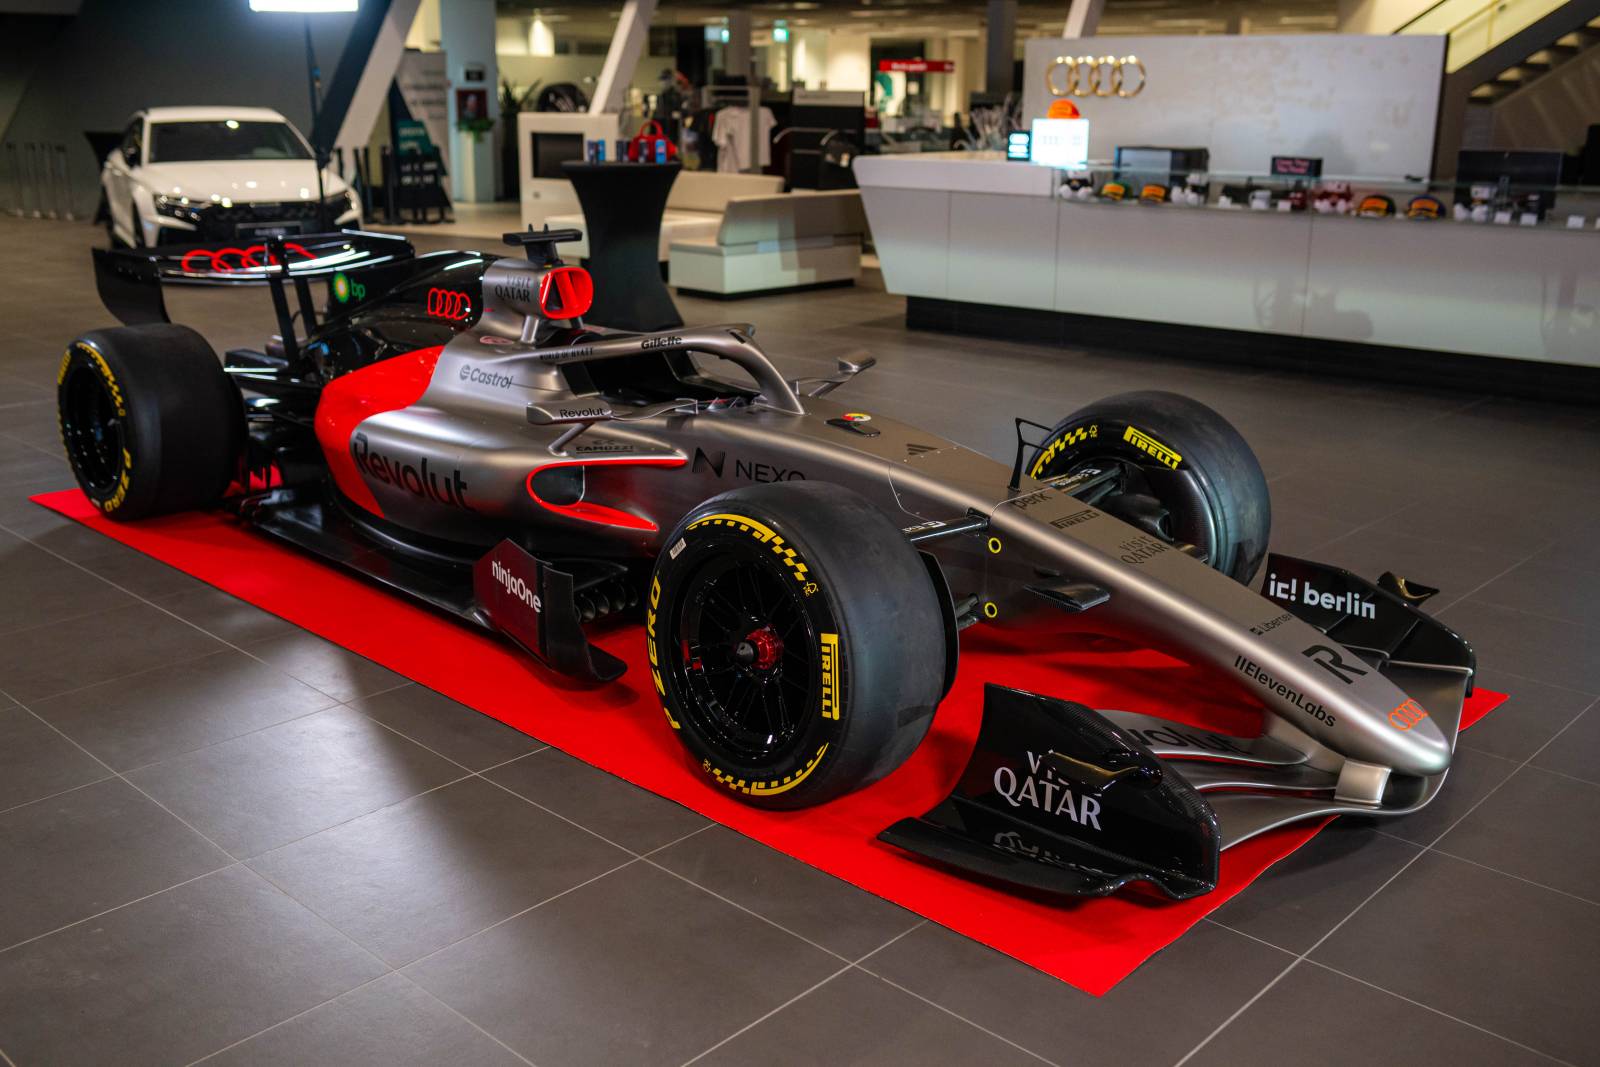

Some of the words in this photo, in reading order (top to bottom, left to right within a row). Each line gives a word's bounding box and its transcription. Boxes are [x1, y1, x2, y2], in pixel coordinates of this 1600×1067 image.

[351, 278, 366, 301] bp
[495, 284, 530, 302] QATAR
[641, 336, 682, 350] Gillette
[470, 368, 513, 390] Castrol
[560, 407, 605, 418] Revolut
[1123, 426, 1182, 470] PIRELLI
[353, 432, 477, 512] Revolut
[1010, 491, 1052, 510] perk
[1050, 509, 1099, 529] PIRELLI
[1121, 543, 1169, 564] QATAR
[491, 560, 542, 613] ninjaOne
[1303, 581, 1376, 619] berlin
[647, 575, 665, 696] ZERO
[820, 633, 840, 720] PIRELLI
[993, 766, 1102, 831] QATAR
